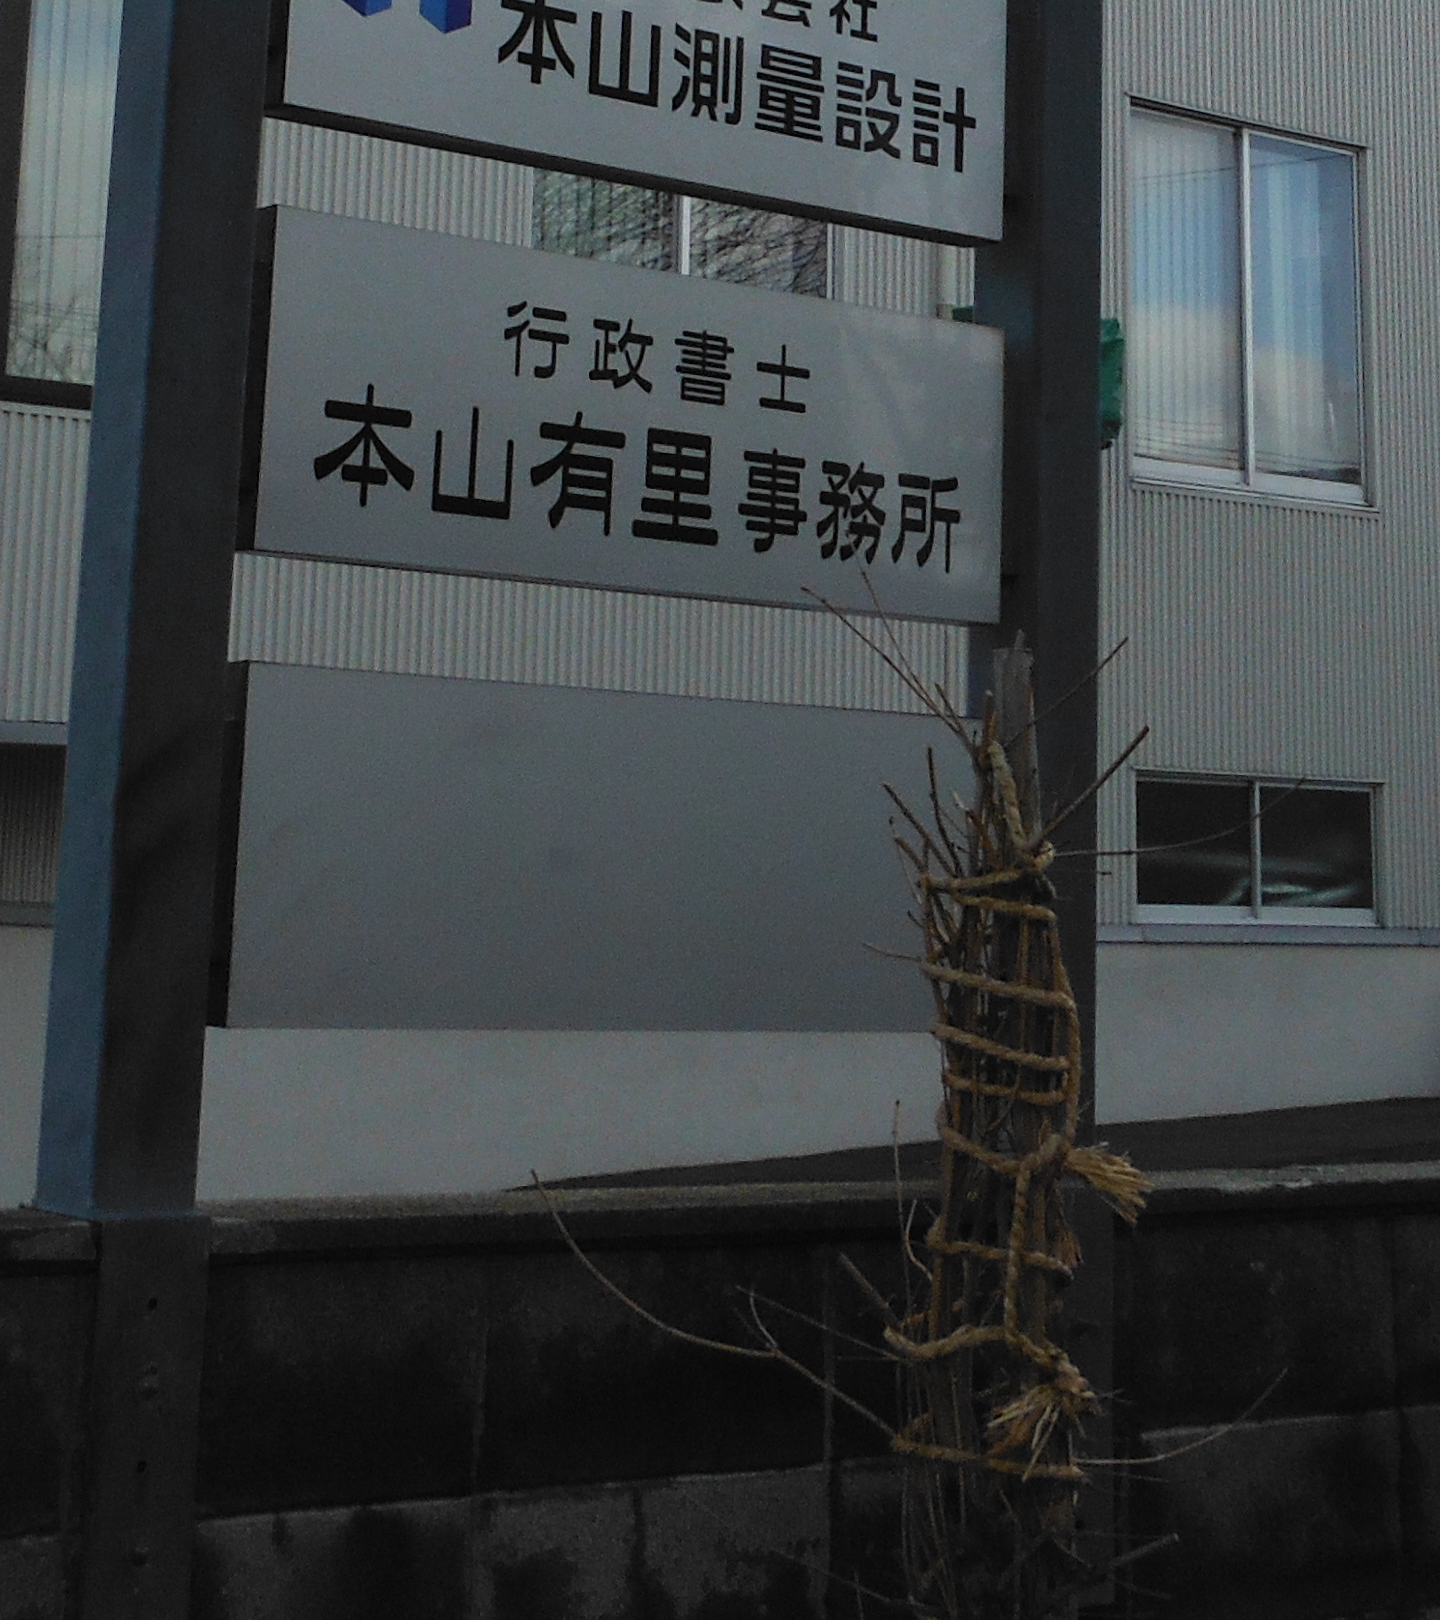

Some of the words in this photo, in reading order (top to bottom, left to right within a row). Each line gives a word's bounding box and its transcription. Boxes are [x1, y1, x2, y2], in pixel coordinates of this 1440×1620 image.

[503, 300, 811, 414] 行政書士
[313, 383, 961, 574] 本山有里事務所
